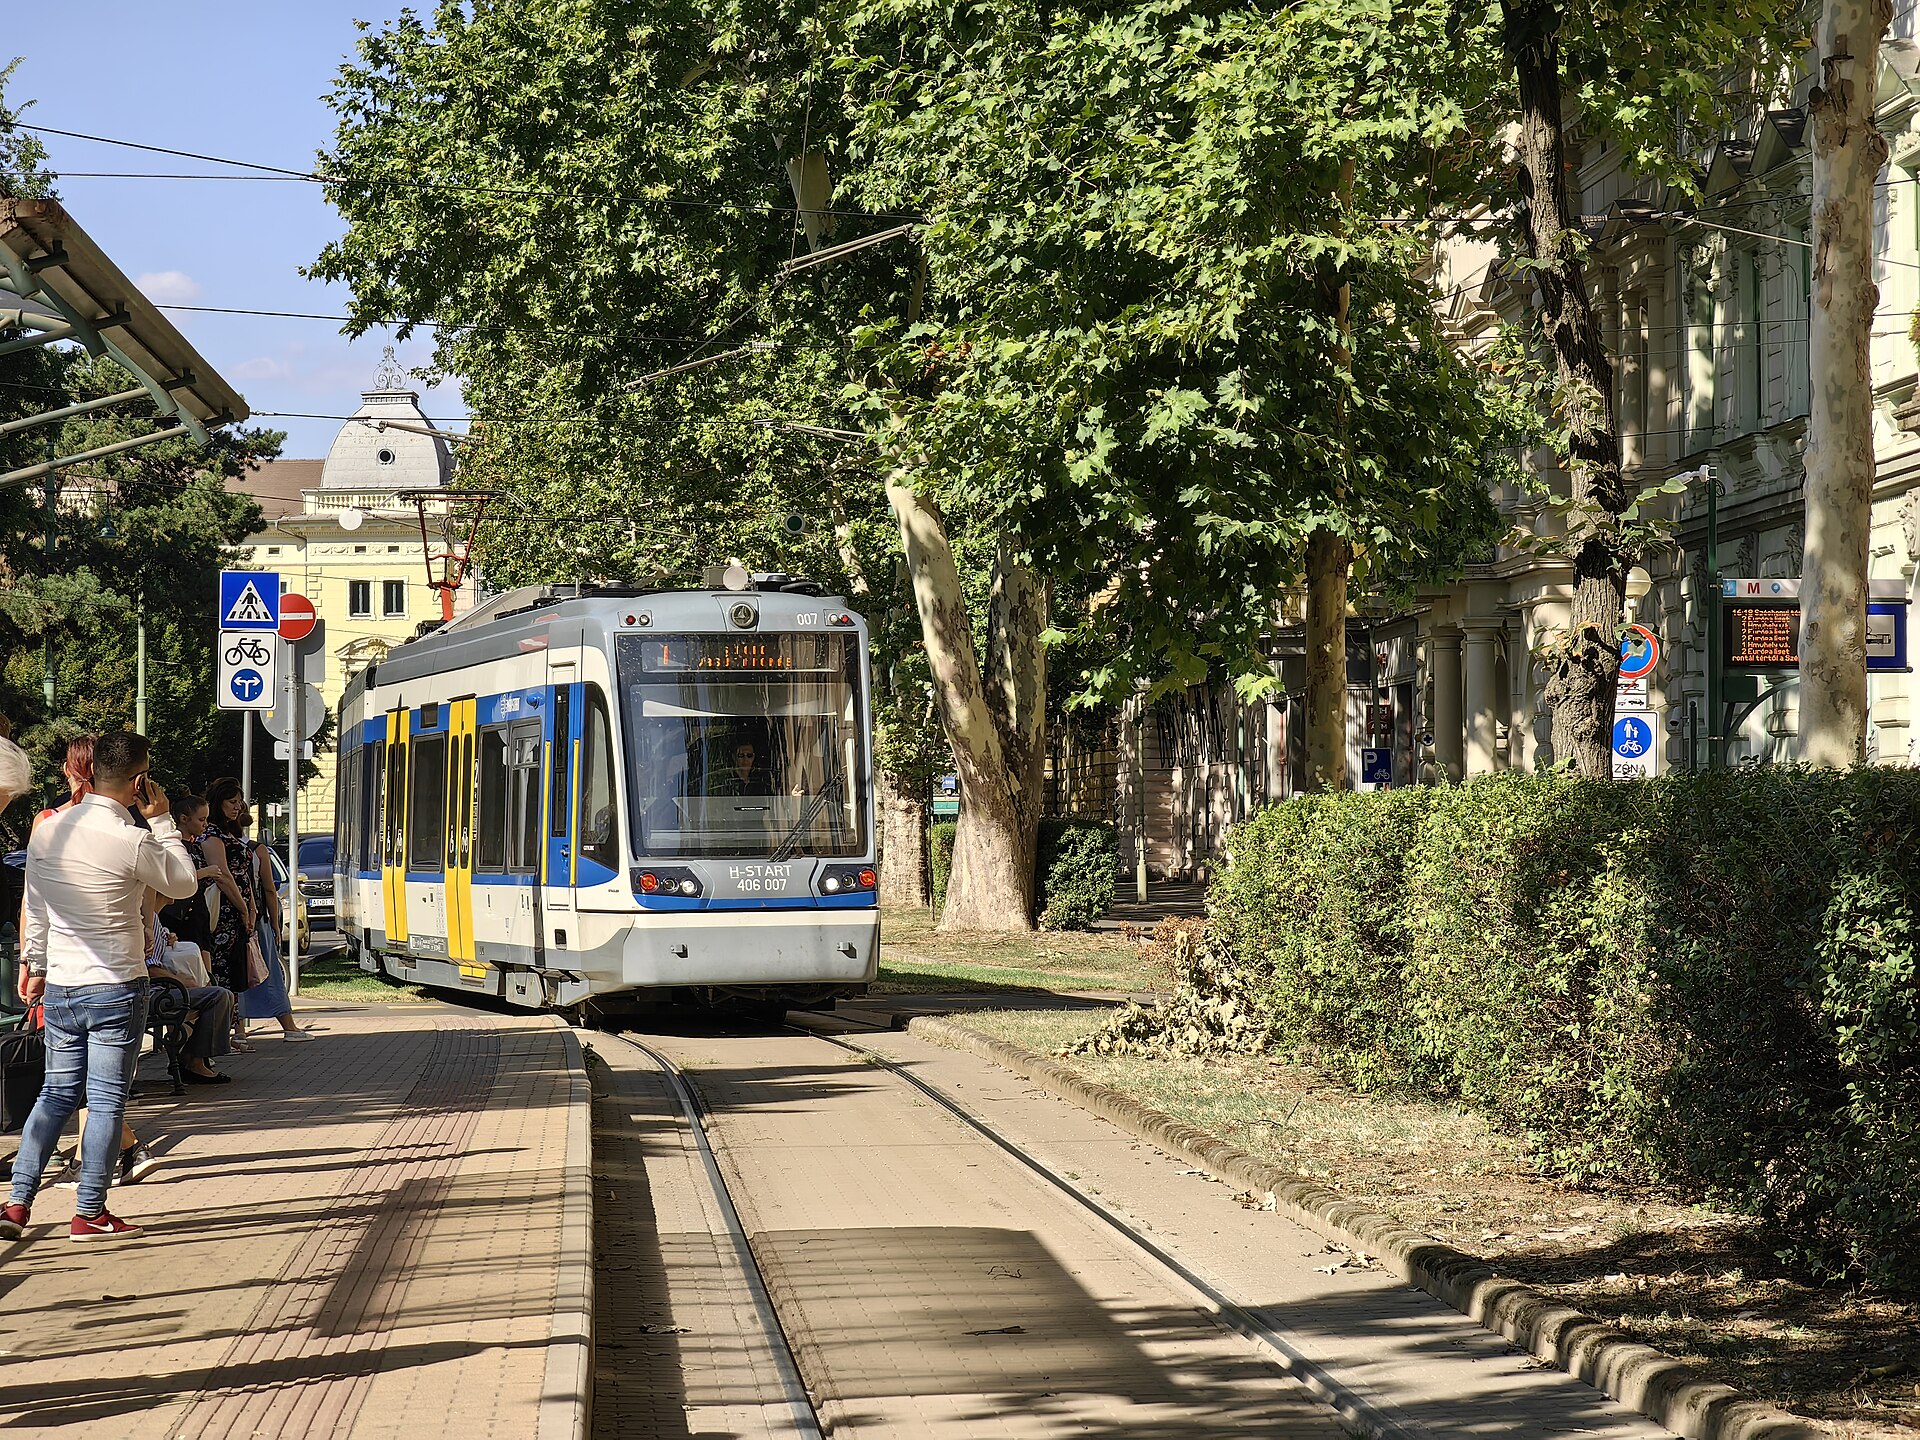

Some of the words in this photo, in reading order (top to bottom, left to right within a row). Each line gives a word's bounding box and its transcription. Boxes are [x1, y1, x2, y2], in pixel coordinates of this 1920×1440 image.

[1747, 582, 1760, 594] M
[796, 613, 818, 625] 007
[1364, 751, 1378, 771] P
[729, 865, 792, 879] H-START
[736, 878, 761, 891] 406
[764, 878, 787, 891] 007
